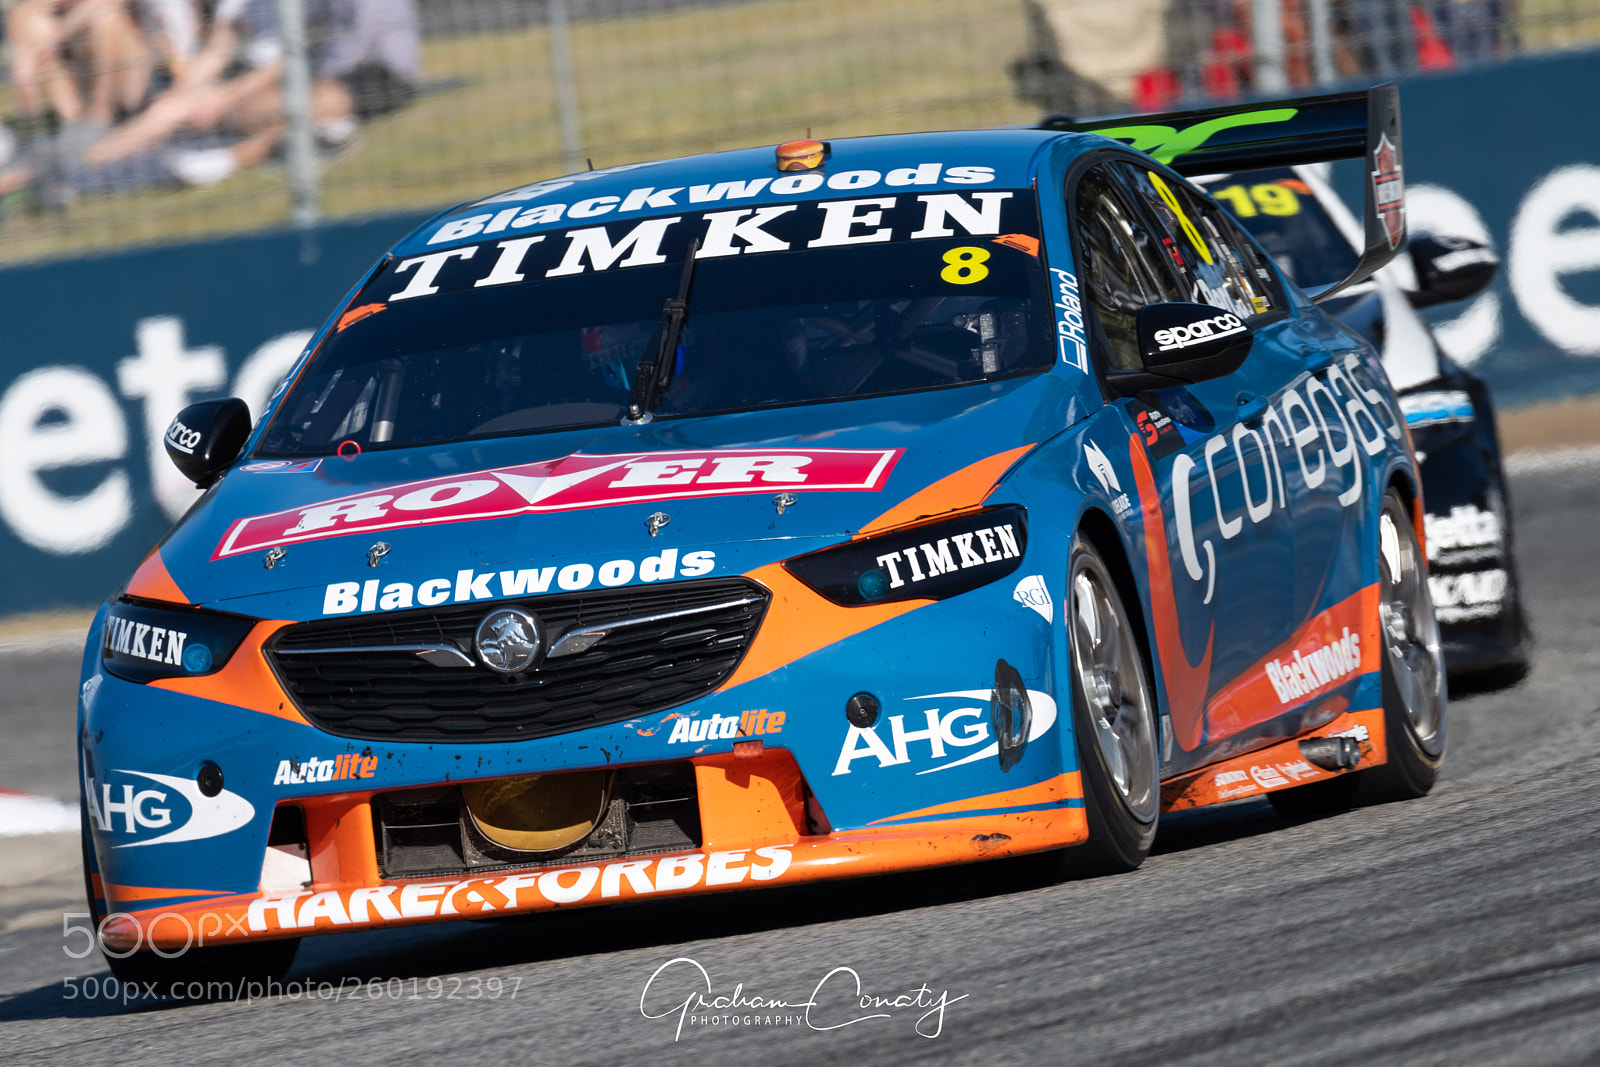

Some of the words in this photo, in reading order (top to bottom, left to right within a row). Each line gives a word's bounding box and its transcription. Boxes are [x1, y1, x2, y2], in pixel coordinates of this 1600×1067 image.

[427, 161, 996, 246] Blackwoods
[1147, 170, 1214, 266] 8
[1211, 182, 1301, 218] 19
[388, 190, 1013, 302] TIMKEN
[940, 246, 991, 285] 8
[1049, 267, 1087, 345] Roland
[1154, 312, 1242, 350] sparco
[1204, 353, 1402, 540] coregas
[282, 452, 813, 537] ROVER
[321, 547, 717, 615] Blackwoods
[876, 523, 1020, 591] TIMKEN
[104, 614, 187, 666] TIMKEN
[1264, 626, 1361, 704] Blackwoods
[667, 708, 786, 744] Autolite
[831, 707, 990, 777] AHG
[273, 752, 379, 786] Autolite
[86, 777, 172, 834] AHG
